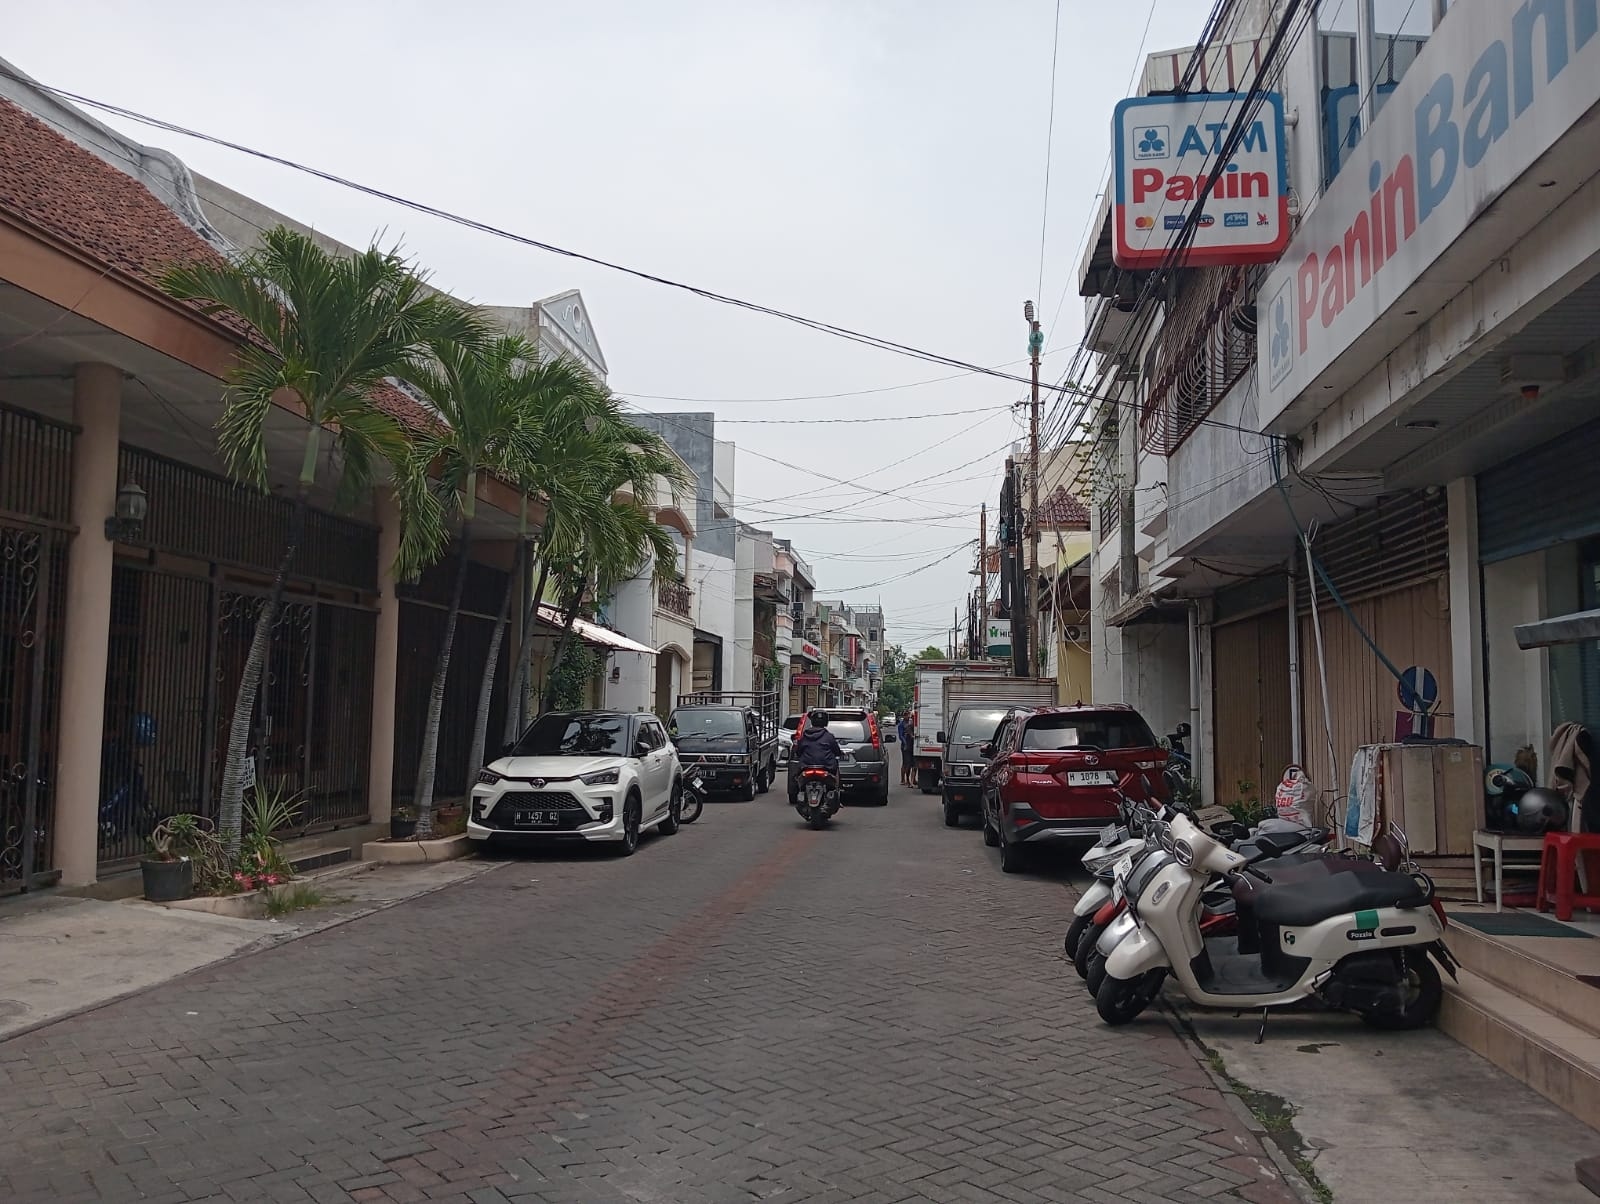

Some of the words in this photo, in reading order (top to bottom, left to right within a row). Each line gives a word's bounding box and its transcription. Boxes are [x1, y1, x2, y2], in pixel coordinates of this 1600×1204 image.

[1176, 121, 1268, 157] ATM
[1132, 163, 1270, 204] Panin
[1070, 773, 1075, 781] H
[1080, 772, 1099, 781] 1078
[516, 812, 521, 820] H
[528, 811, 543, 820] 1457
